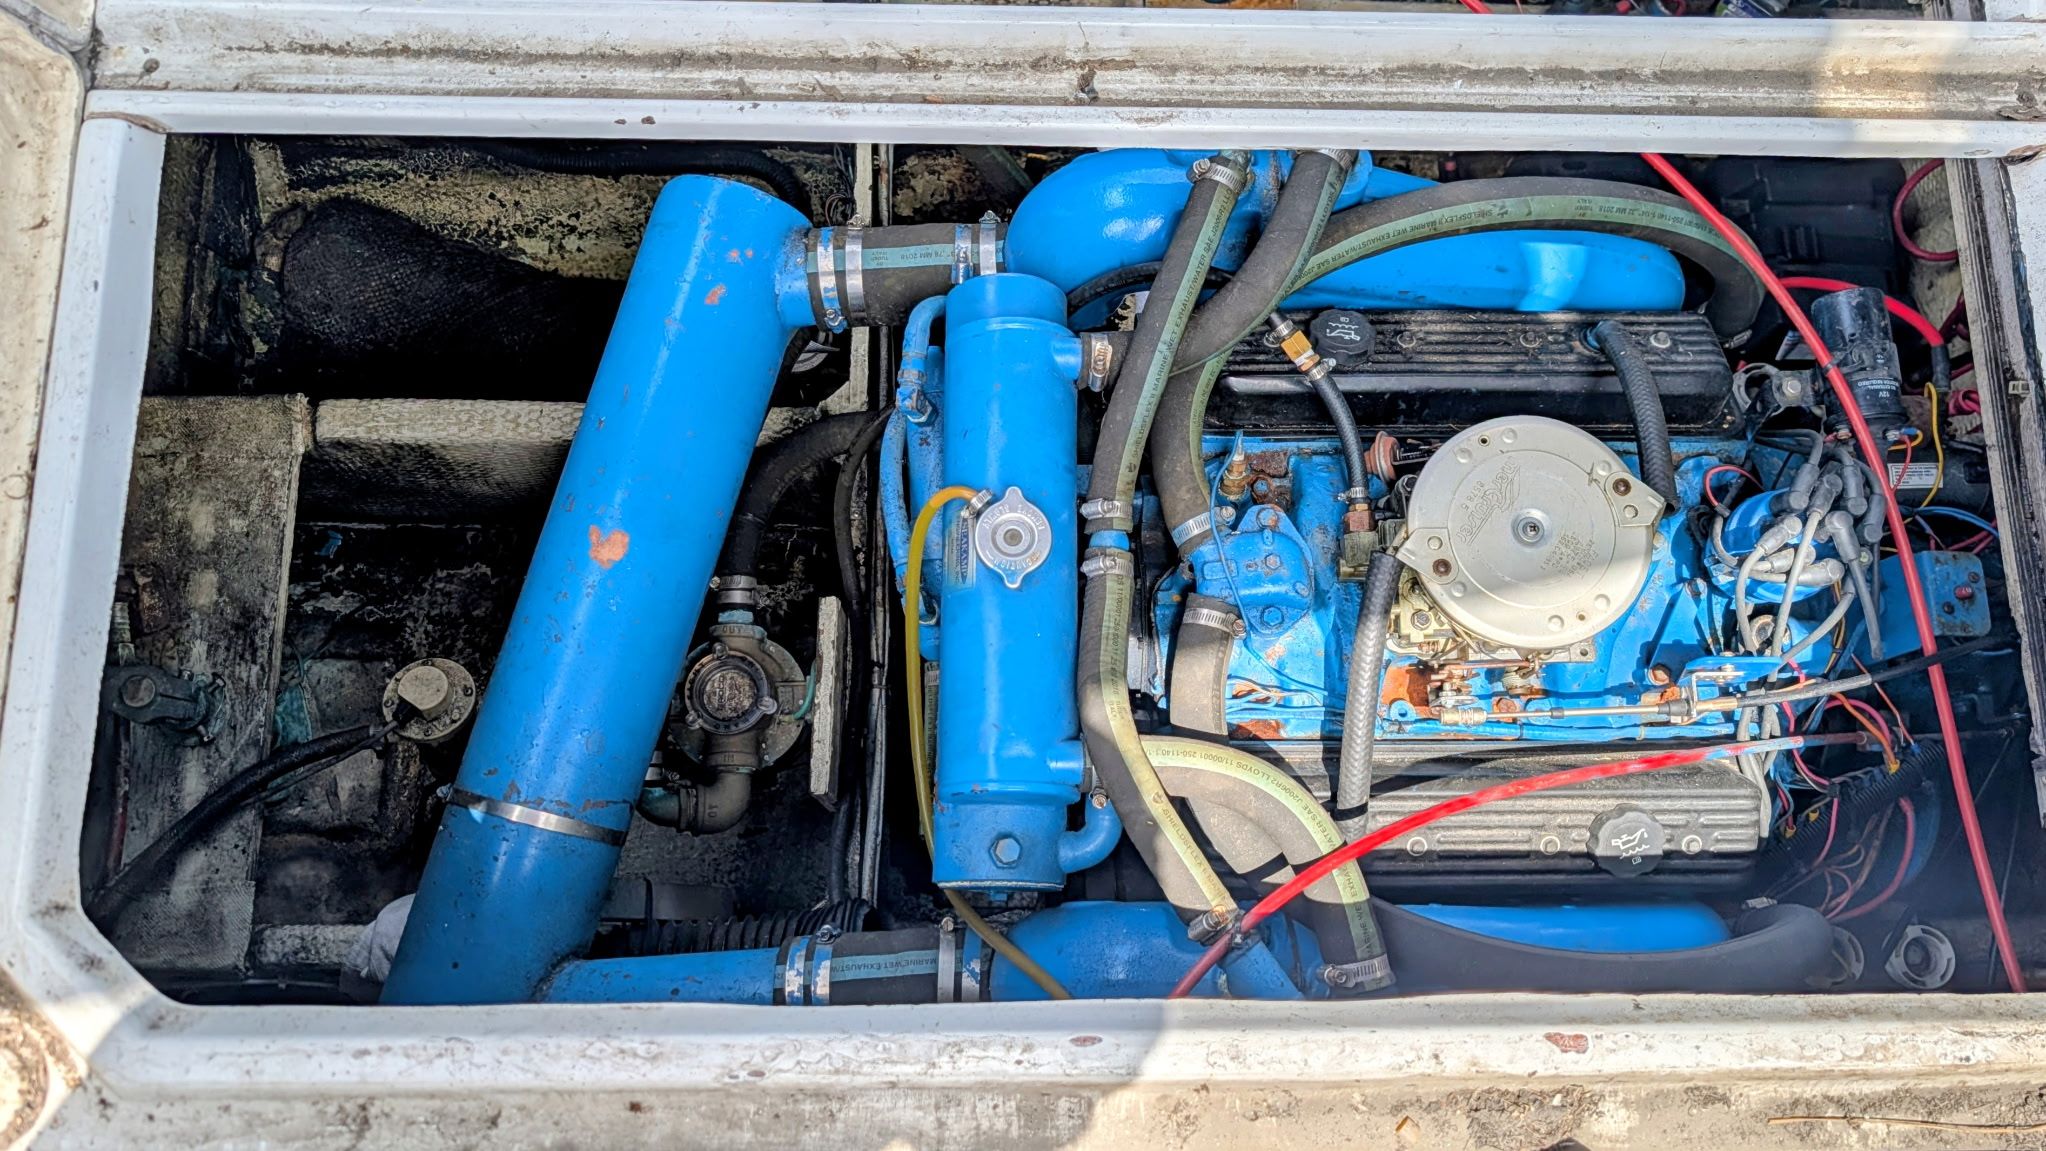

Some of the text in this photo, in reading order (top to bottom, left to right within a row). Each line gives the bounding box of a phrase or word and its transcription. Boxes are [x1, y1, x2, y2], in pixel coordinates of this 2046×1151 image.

[1444, 209, 1494, 225] SHIELDSFLEX
[1600, 205, 1615, 214] 2018
[1391, 225, 1409, 239] WET
[1409, 218, 1437, 233] MARINE
[1331, 231, 1391, 263] EXHAUST/WATER
[900, 252, 918, 260] 2018
[1316, 257, 1331, 270] SAE
[1301, 267, 1315, 280] J200
[1132, 400, 1153, 459] SHIELDSFLEX
[1154, 354, 1168, 392] MARINE
[1167, 331, 1177, 352] WET
[1175, 255, 1206, 327] EXHAUST/WATER
[1203, 238, 1214, 253] SAE
[1224, 189, 1233, 202] LLO
[1161, 749, 1197, 759] 250-1140
[1203, 753, 1235, 768] 11/00001
[1235, 761, 1271, 780] LLOYDS
[1270, 777, 1303, 804] J2006R2
[1303, 803, 1318, 821] SAE
[831, 958, 937, 974] MARINE WET EXHAUST/W
